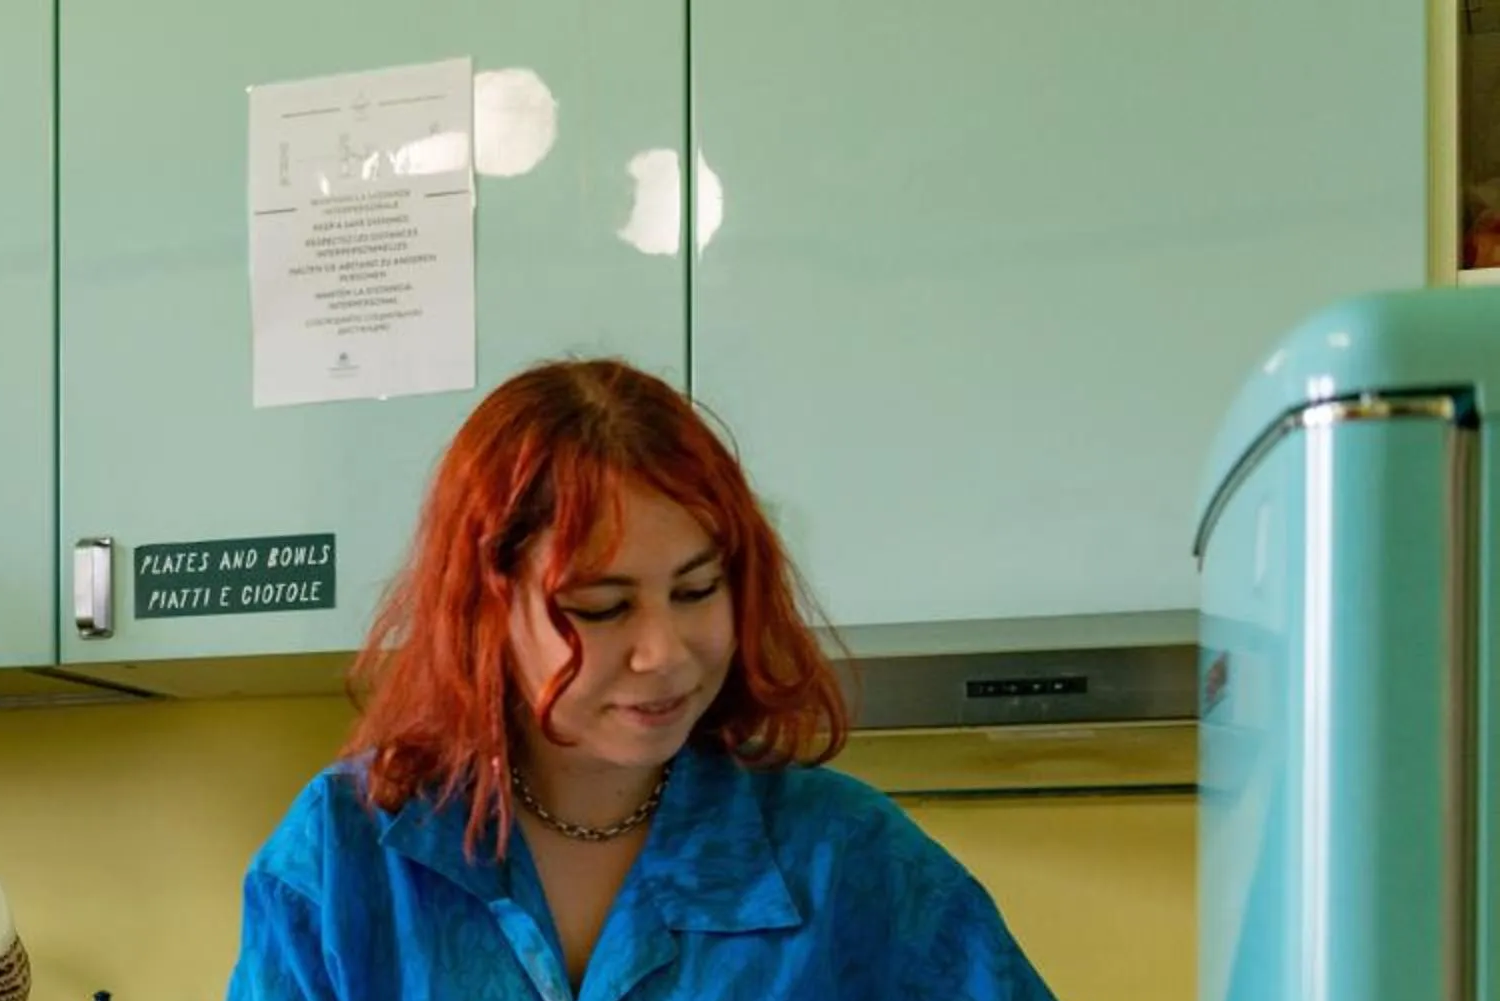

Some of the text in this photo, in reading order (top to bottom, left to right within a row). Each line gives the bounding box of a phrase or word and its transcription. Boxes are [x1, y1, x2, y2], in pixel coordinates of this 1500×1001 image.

[140, 545, 331, 575] PLATES AND BOWLS
[148, 581, 323, 611] PIATTI E CIOTOLE
